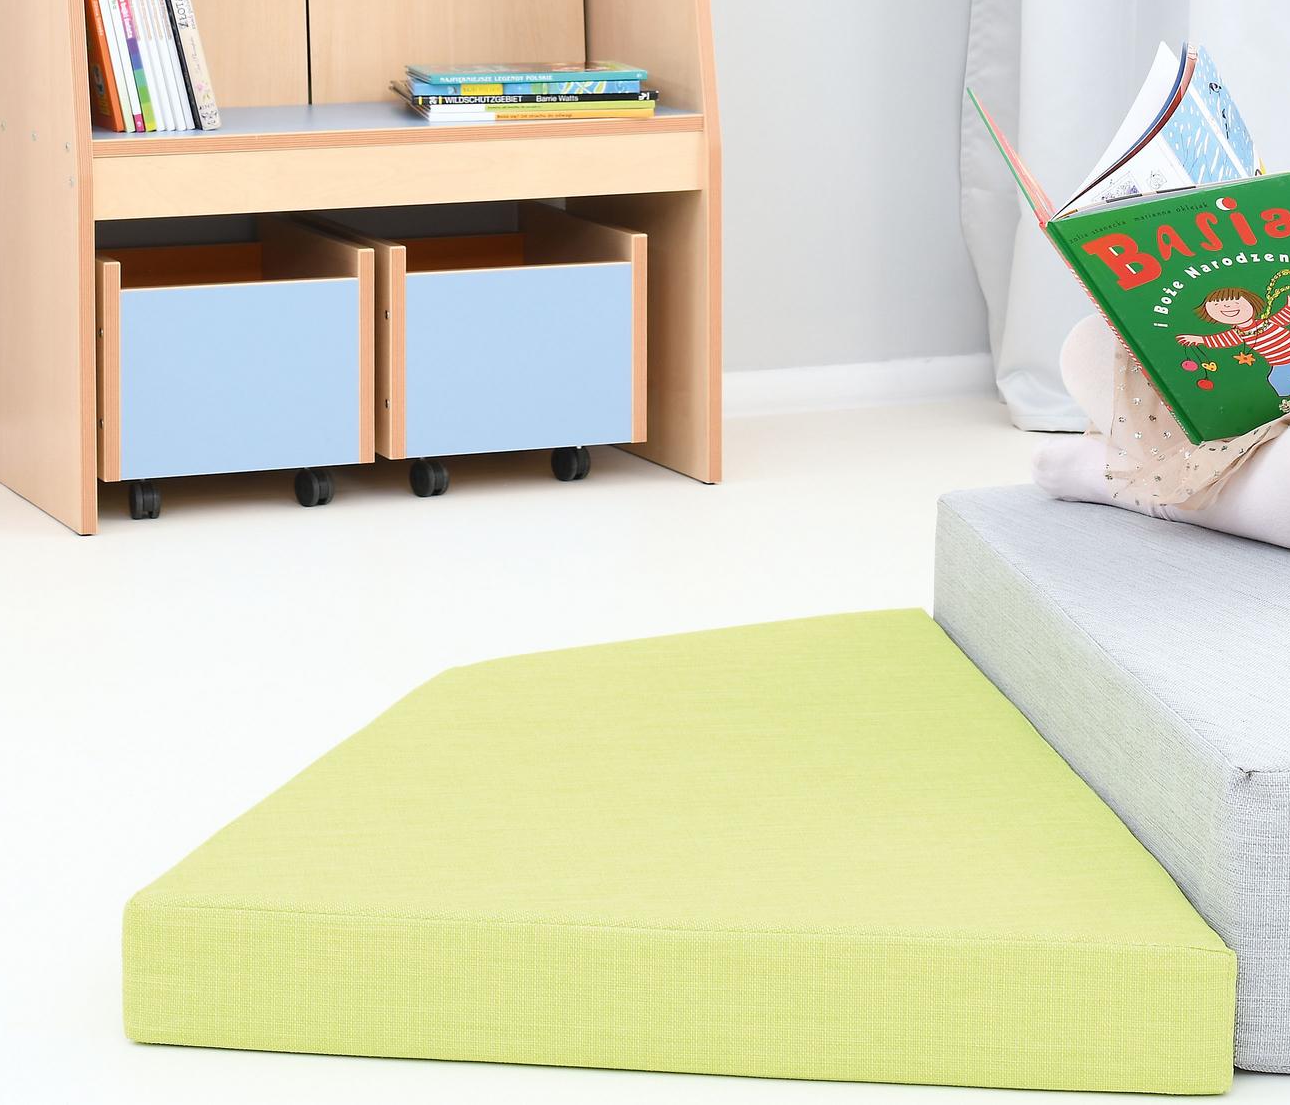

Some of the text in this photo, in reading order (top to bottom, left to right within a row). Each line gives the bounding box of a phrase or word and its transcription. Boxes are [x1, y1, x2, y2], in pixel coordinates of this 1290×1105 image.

[444, 94, 579, 104] WILDSCHUTZGEBIET Barrie Watts
[1153, 280, 1185, 315] Boże
